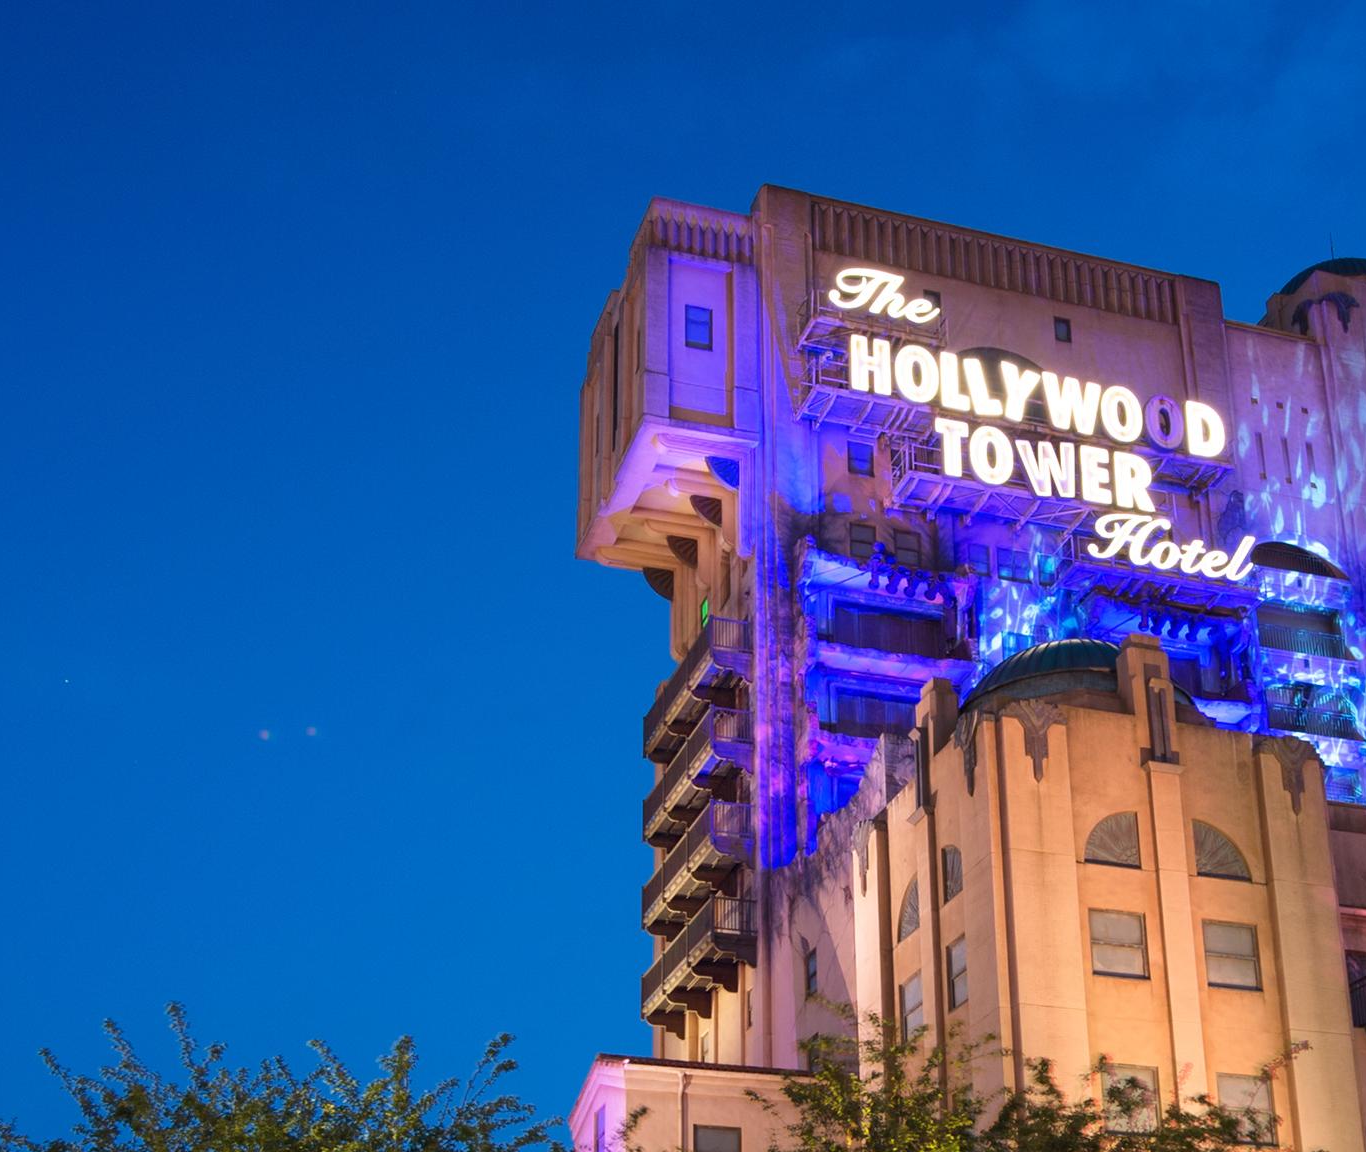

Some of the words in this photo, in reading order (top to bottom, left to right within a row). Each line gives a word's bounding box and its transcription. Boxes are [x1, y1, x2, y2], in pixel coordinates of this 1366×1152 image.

[829, 267, 940, 324] The
[849, 333, 1226, 458] HOLLYWOOD
[935, 417, 1156, 512] TOWER
[1087, 512, 1255, 581] Hotel
